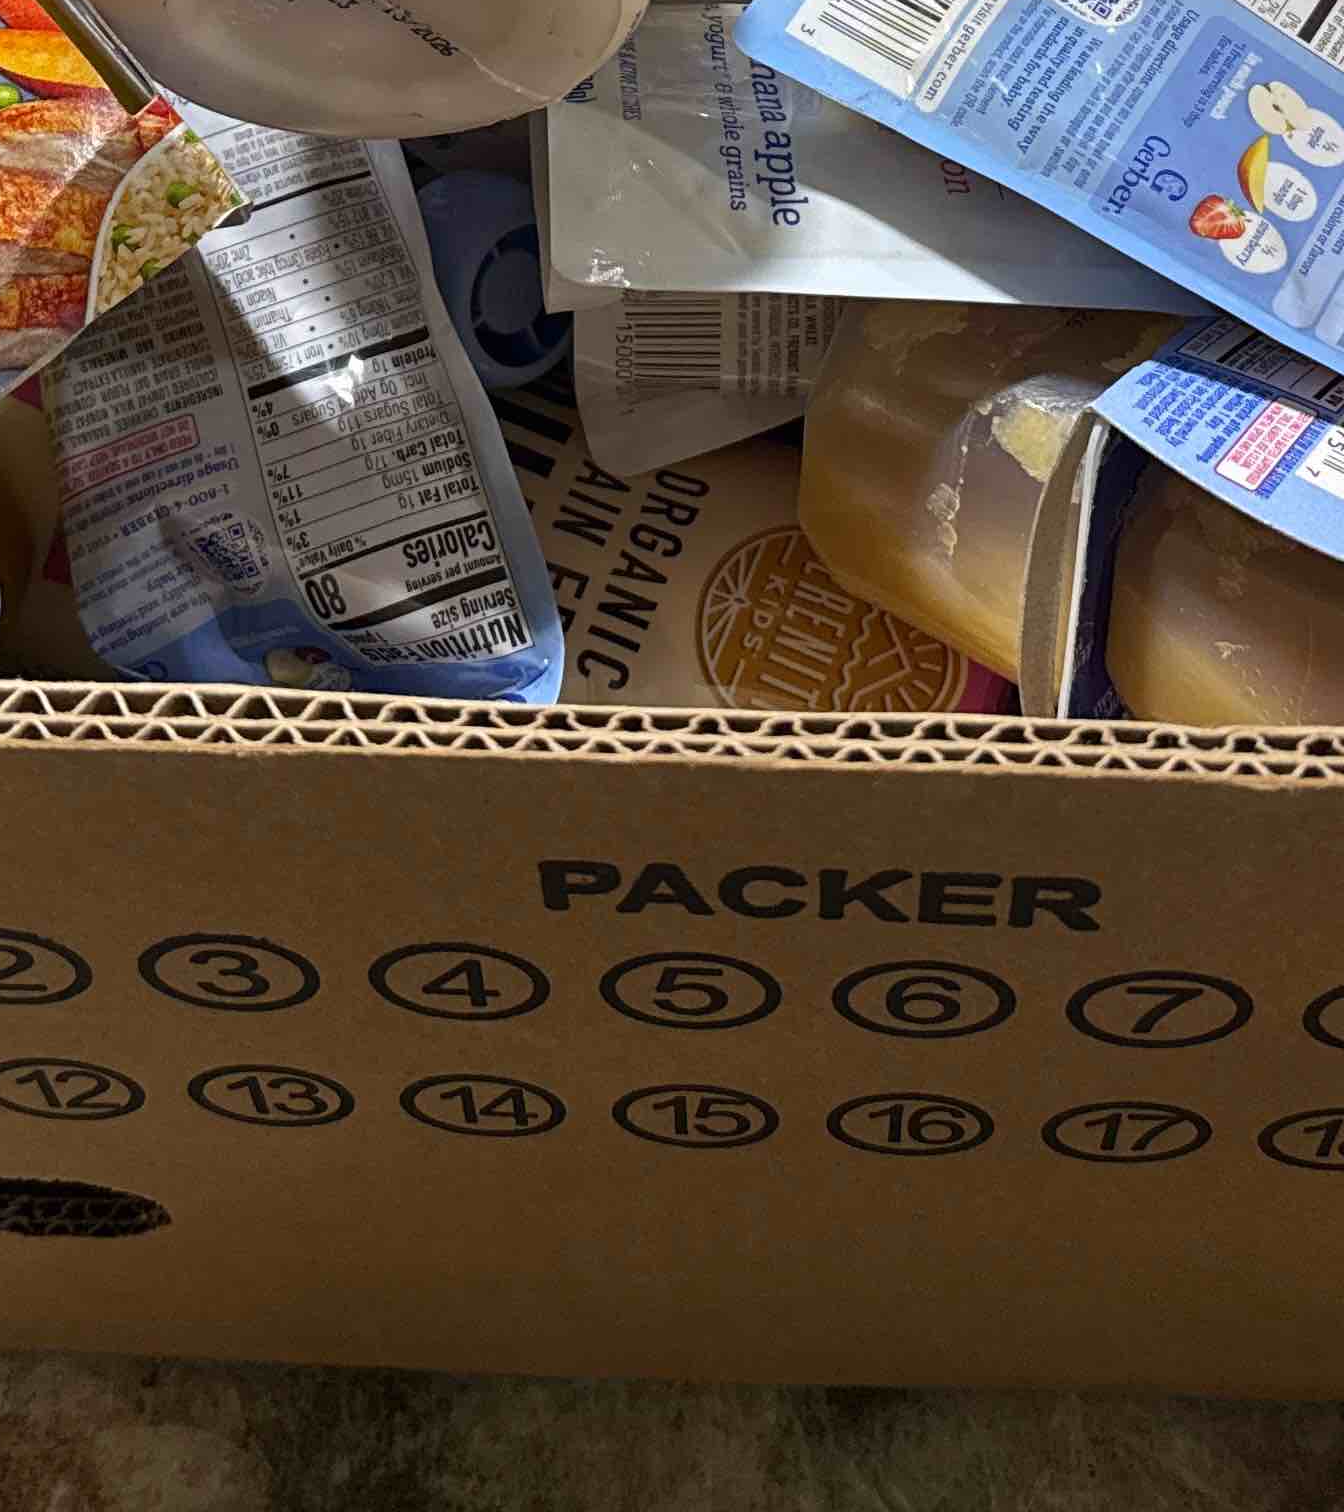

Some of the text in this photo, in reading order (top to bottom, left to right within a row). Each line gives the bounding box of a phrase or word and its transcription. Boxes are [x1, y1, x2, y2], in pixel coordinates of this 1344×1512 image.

[976, 0, 994, 24] visit
[1171, 9, 1201, 41] Usage
[1008, 87, 1040, 132] testing
[719, 94, 747, 212] whole grains
[1017, 125, 1040, 155] way
[756, 131, 809, 227] apple
[1108, 135, 1171, 215] Gerber
[382, 465, 421, 489] 15mg
[399, 476, 479, 509] Total Fat 1g
[1306, 466, 1320, 478] 7
[403, 520, 495, 568] Calories
[306, 572, 347, 619] 80
[577, 469, 709, 692] ORGANIC
[431, 587, 516, 631] Serving size
[744, 575, 787, 651] KIDS
[538, 859, 1102, 931] PACKER
